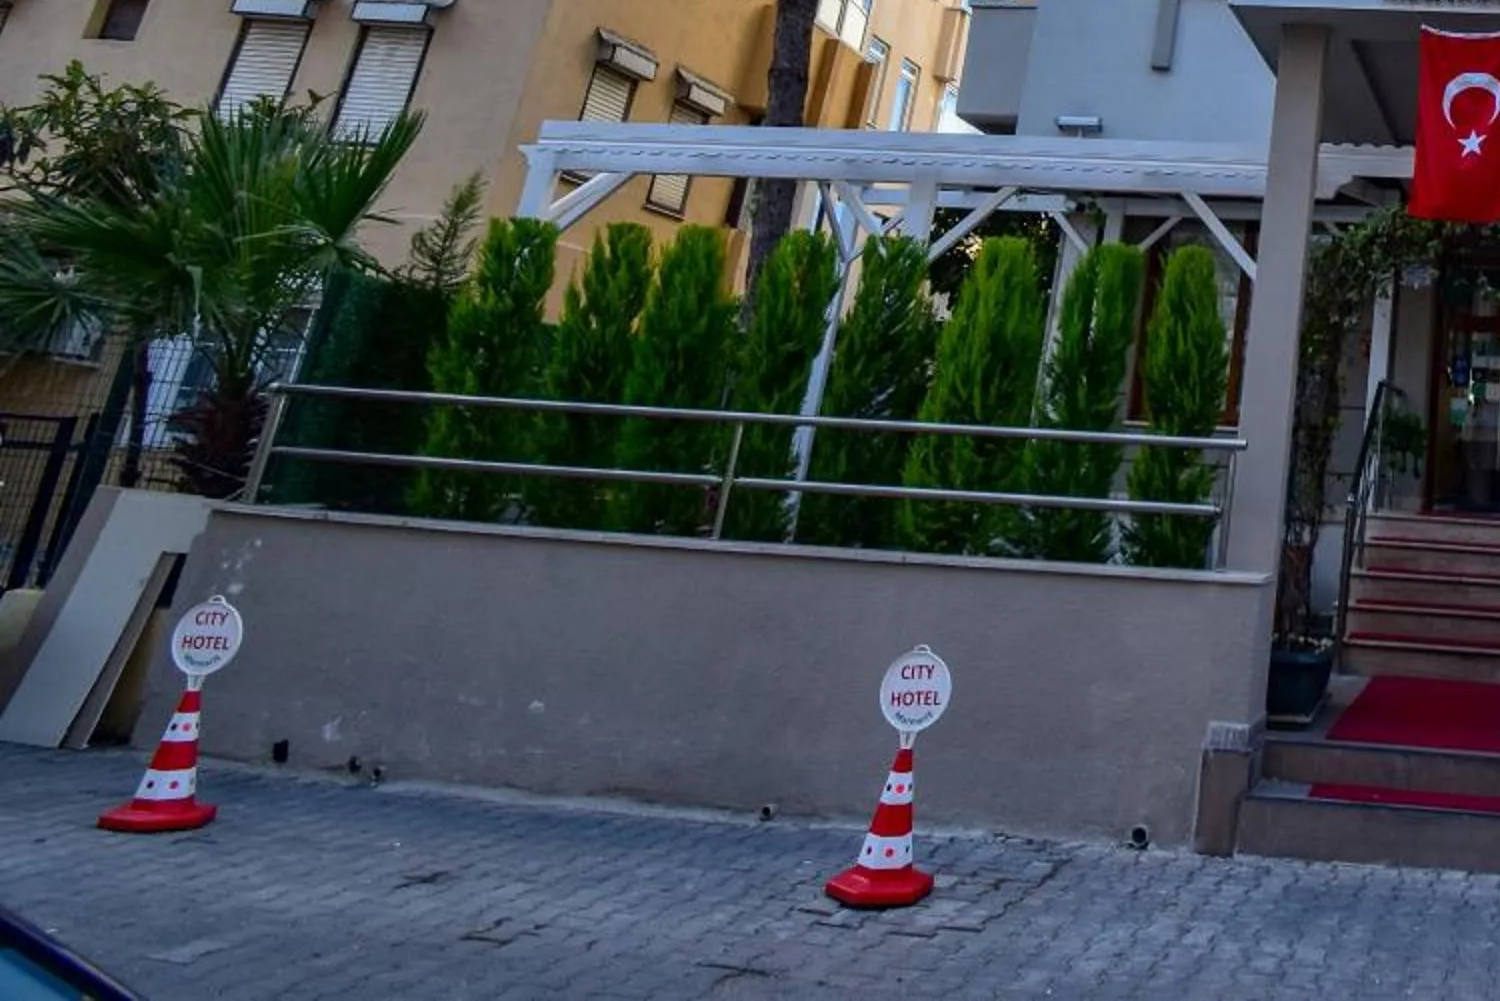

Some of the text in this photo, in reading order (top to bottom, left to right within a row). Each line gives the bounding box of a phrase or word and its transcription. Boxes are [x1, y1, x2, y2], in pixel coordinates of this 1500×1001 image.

[195, 610, 229, 626] CITY
[181, 634, 230, 650] HOTEL
[901, 664, 935, 680] CITY
[890, 690, 942, 707] HOTEL
